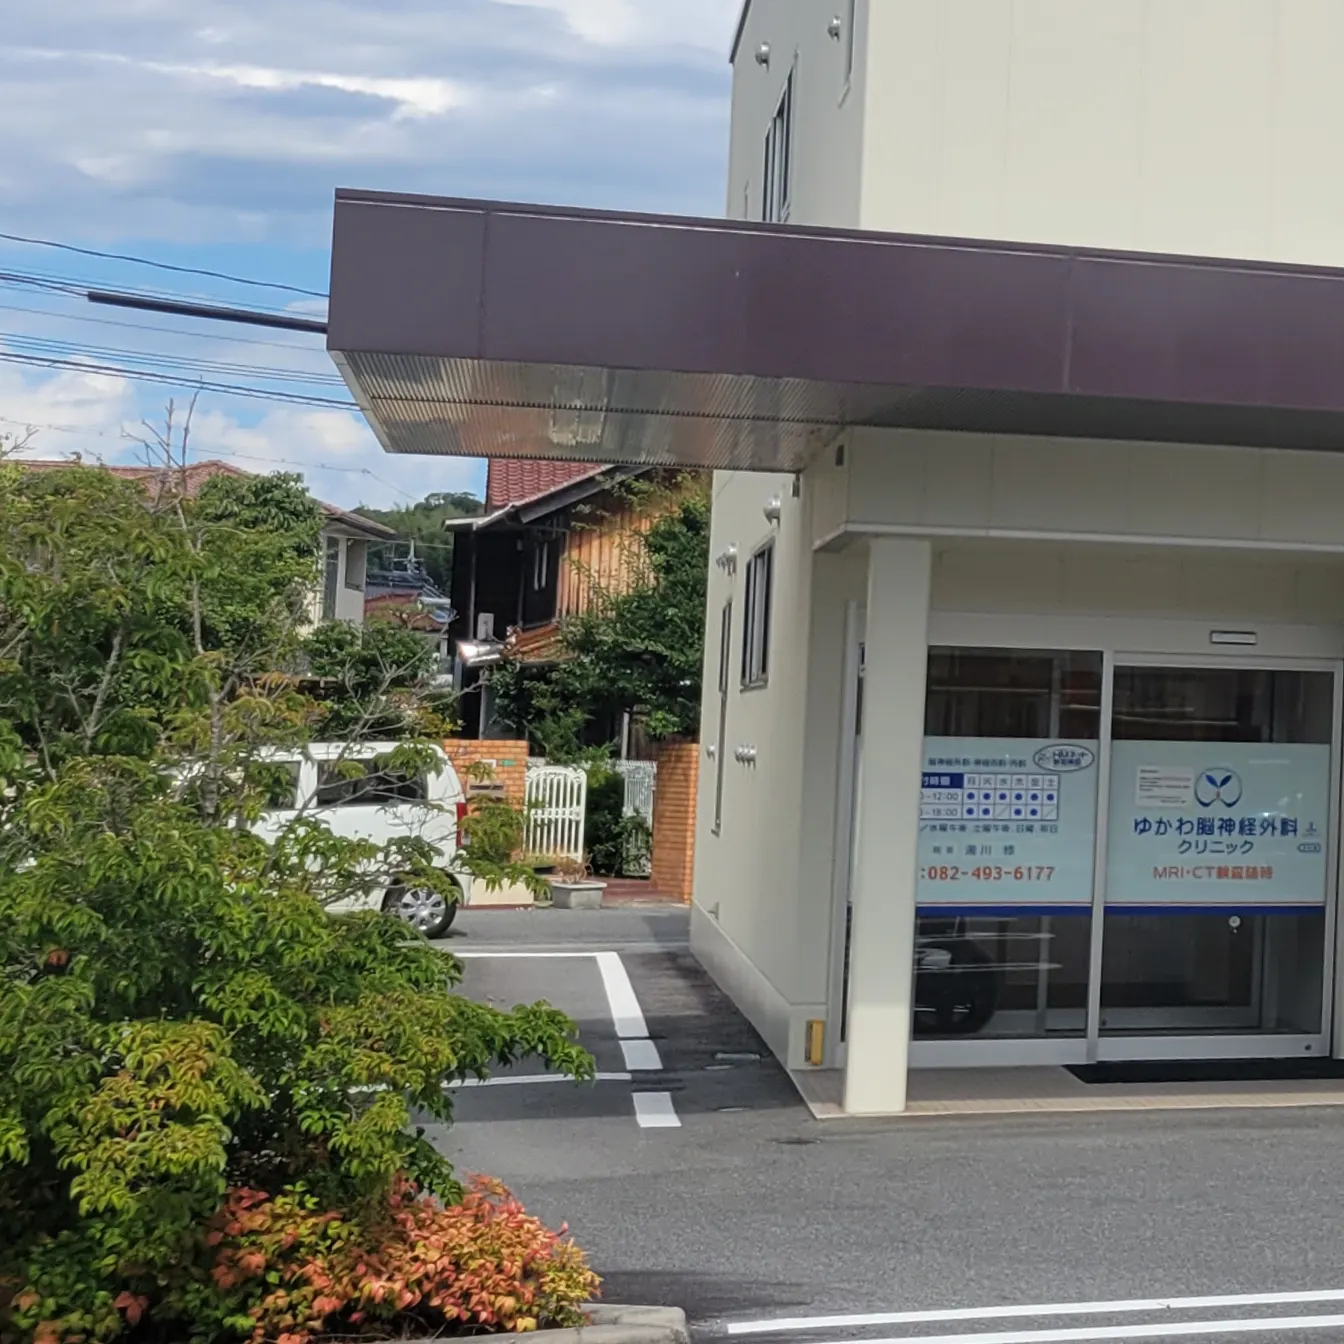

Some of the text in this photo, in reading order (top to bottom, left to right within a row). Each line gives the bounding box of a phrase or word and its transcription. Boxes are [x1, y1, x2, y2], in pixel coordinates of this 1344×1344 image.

[1134, 816, 1298, 837] ゆかわ脳神経外科
[1178, 839, 1255, 855] クリニック
